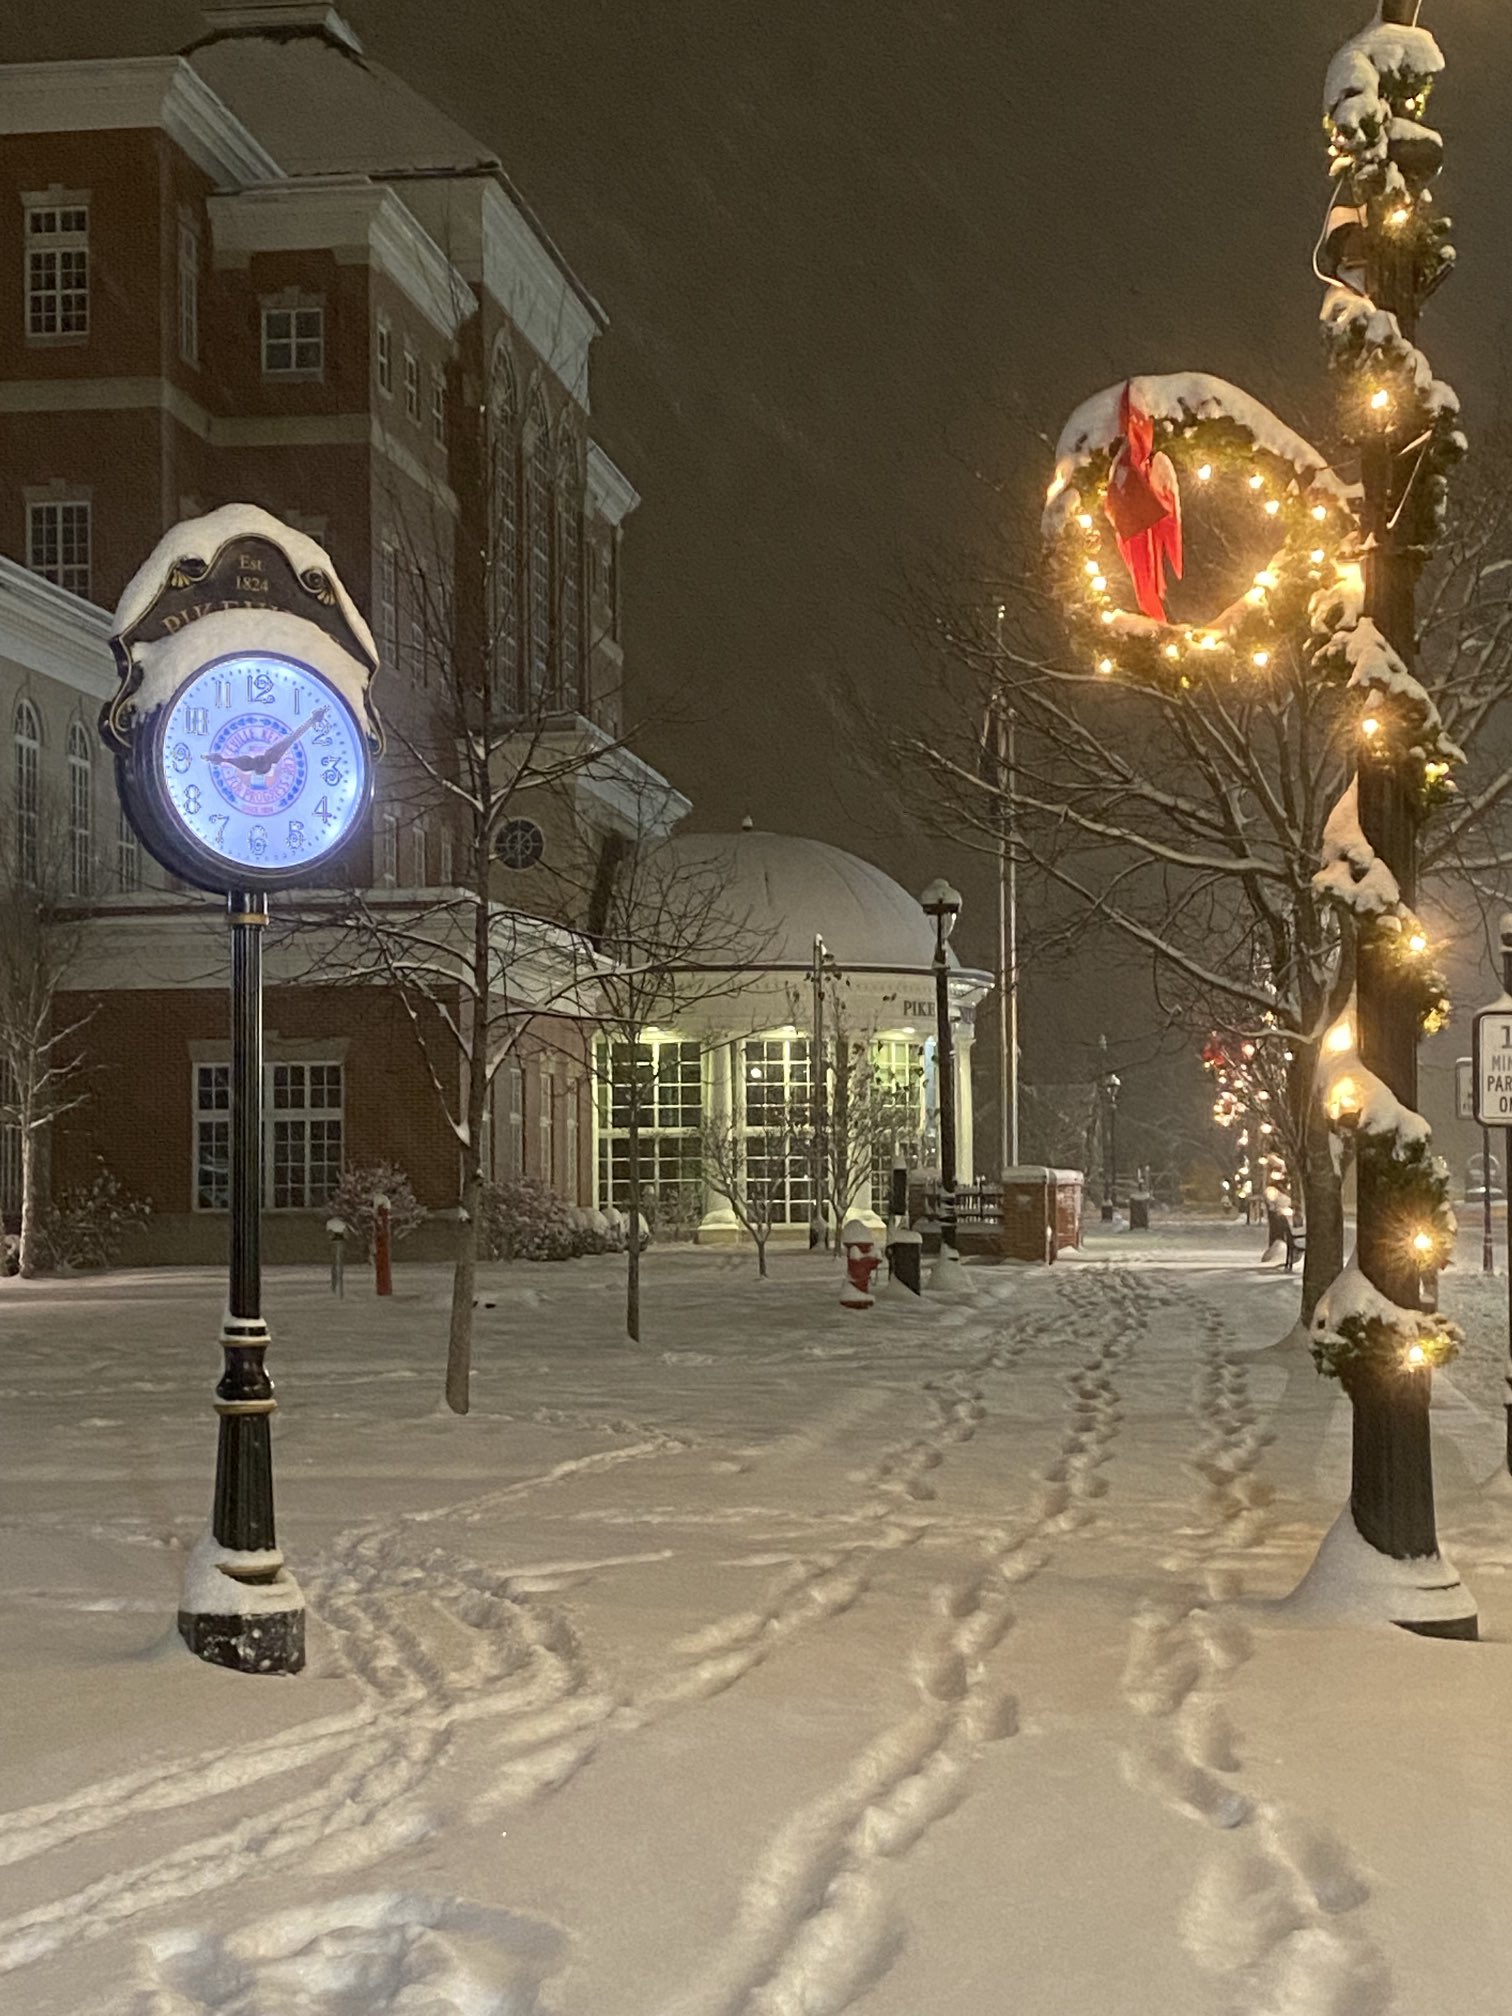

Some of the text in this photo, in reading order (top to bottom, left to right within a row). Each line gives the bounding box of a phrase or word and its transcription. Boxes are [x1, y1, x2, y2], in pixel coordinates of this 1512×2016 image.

[240, 555, 262, 570] Est
[236, 576, 269, 592] 1824
[215, 680, 231, 708] 11
[247, 674, 276, 704] 12
[294, 688, 300, 715] 1
[312, 718, 333, 747] 2
[172, 742, 192, 774] 9
[321, 756, 343, 787] 3
[183, 784, 201, 814] 8
[312, 796, 332, 824] 4
[209, 813, 230, 845] 7
[249, 825, 268, 856] 6
[286, 820, 304, 849] 5
[903, 1000, 936, 1017] PIKE
[1501, 1025, 1512, 1049] 1
[1492, 1055, 1512, 1072] MIN
[1487, 1075, 1512, 1092] PAR
